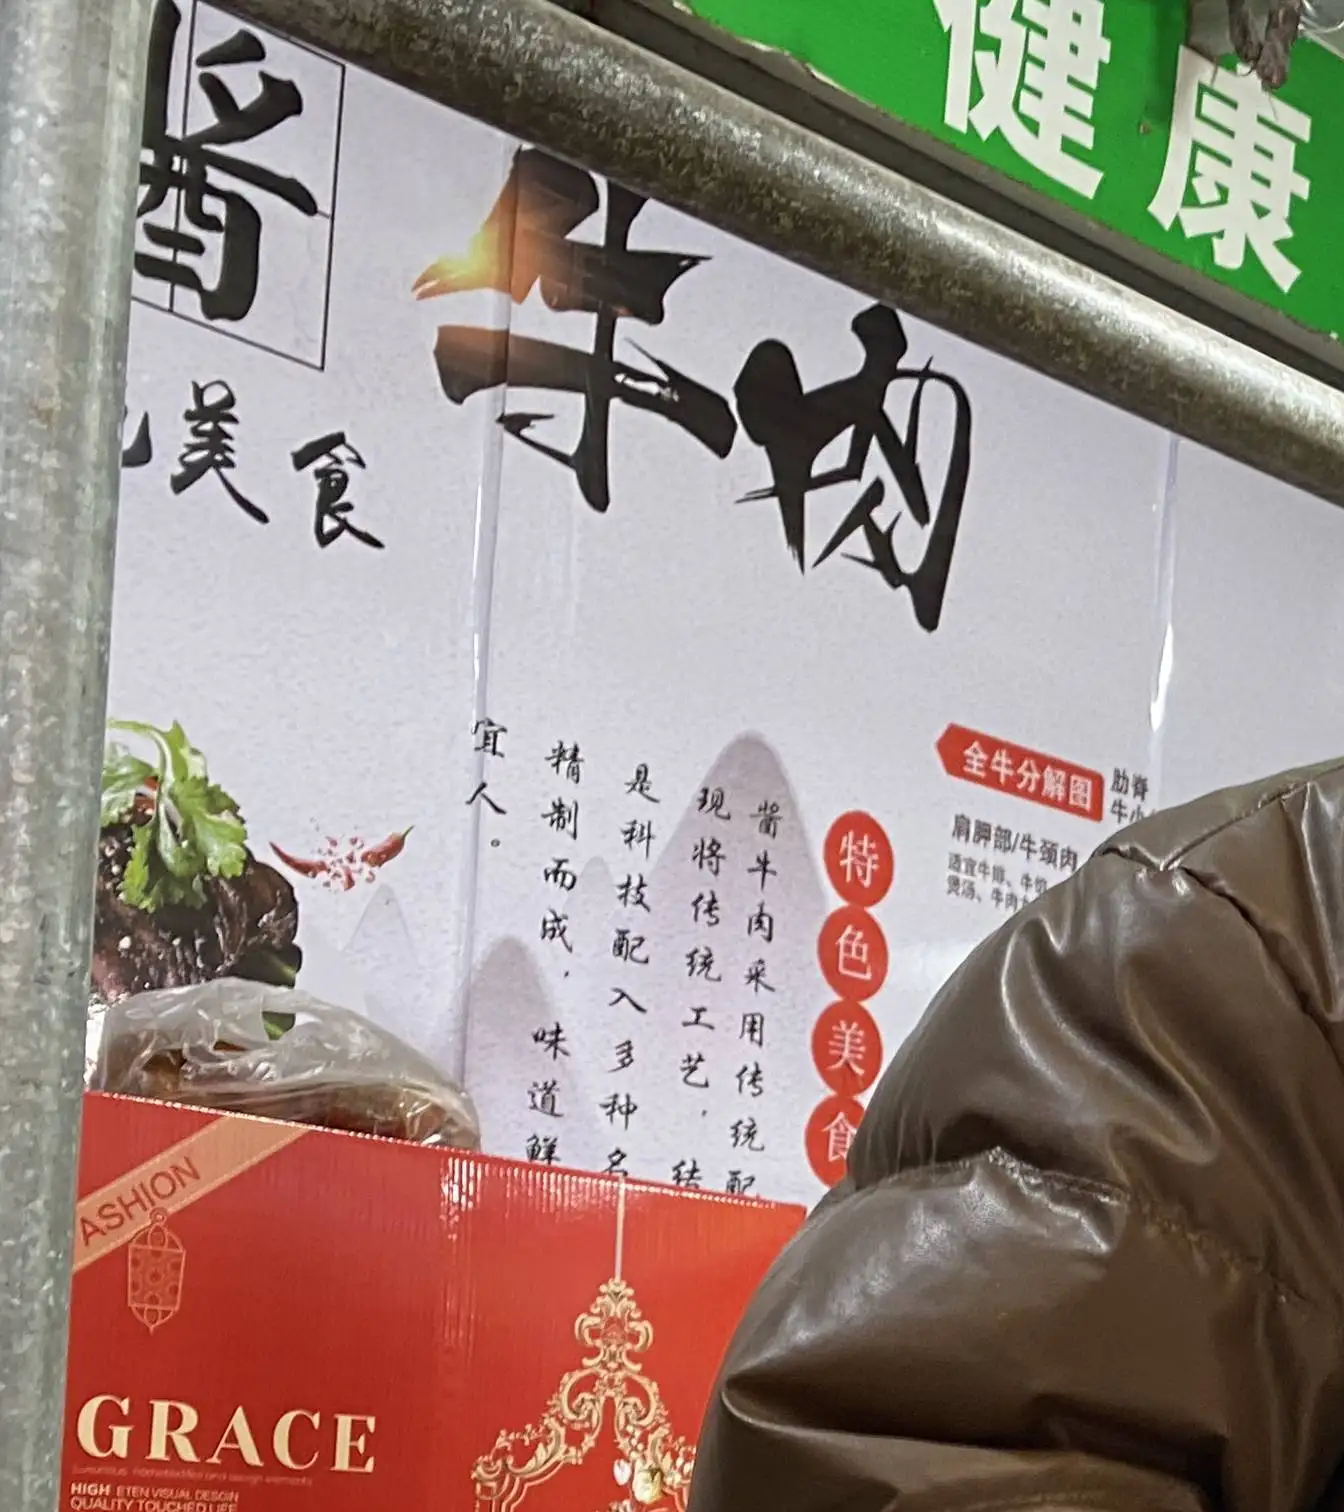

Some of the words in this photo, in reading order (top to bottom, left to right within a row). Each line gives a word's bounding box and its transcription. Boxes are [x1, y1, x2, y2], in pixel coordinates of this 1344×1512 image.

[938, 0, 1313, 294] 健康
[121, 378, 386, 550] 美食
[962, 739, 1094, 814] 全牛分解图
[812, 829, 879, 1163] 特色美食
[79, 1156, 201, 1247] ASHION
[76, 1394, 377, 1474] GRACE
[70, 1482, 112, 1497] HIGH
[151, 1487, 191, 1501] VISUAL
[70, 1496, 134, 1511] QUALITY
